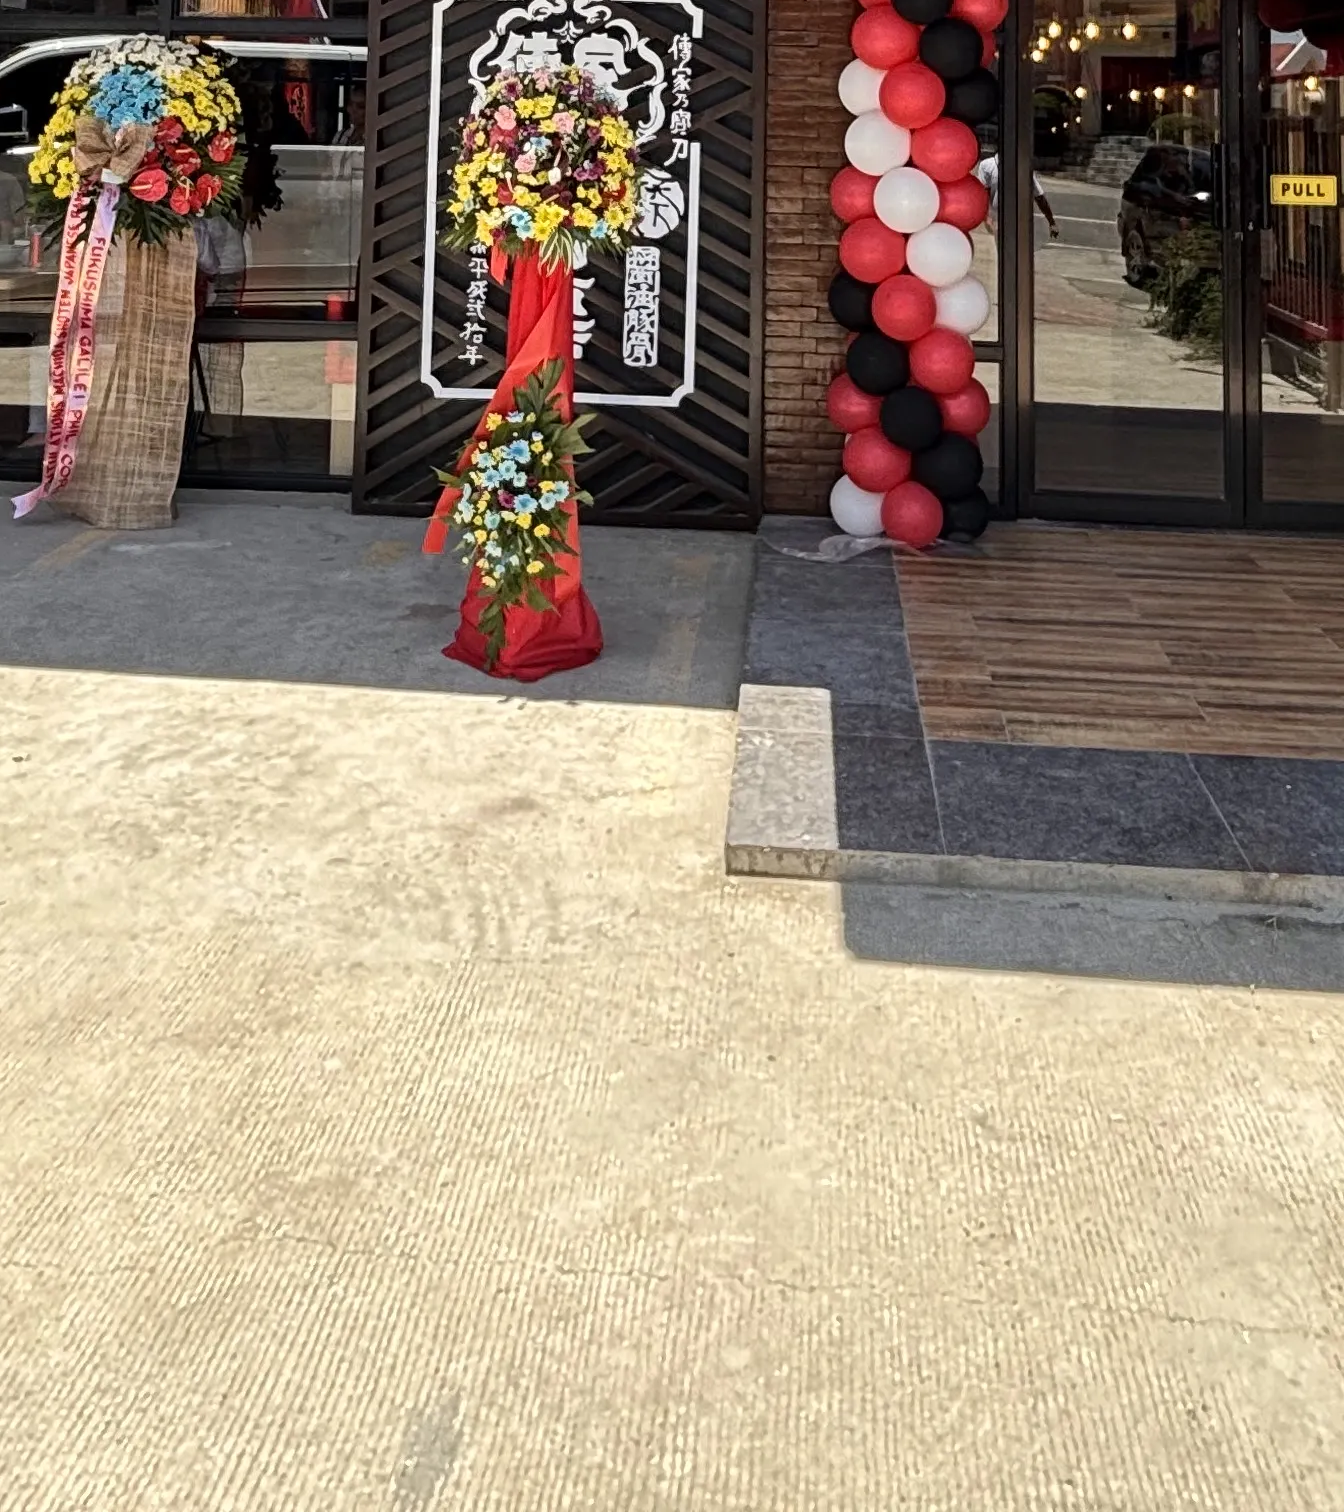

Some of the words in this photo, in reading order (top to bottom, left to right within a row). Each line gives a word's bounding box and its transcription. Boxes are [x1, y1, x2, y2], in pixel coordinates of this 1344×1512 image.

[1281, 182, 1326, 198] PULL
[79, 237, 107, 330] FUKUSHIMA
[50, 340, 66, 396] MACHIDA
[72, 335, 92, 399] GALILEI
